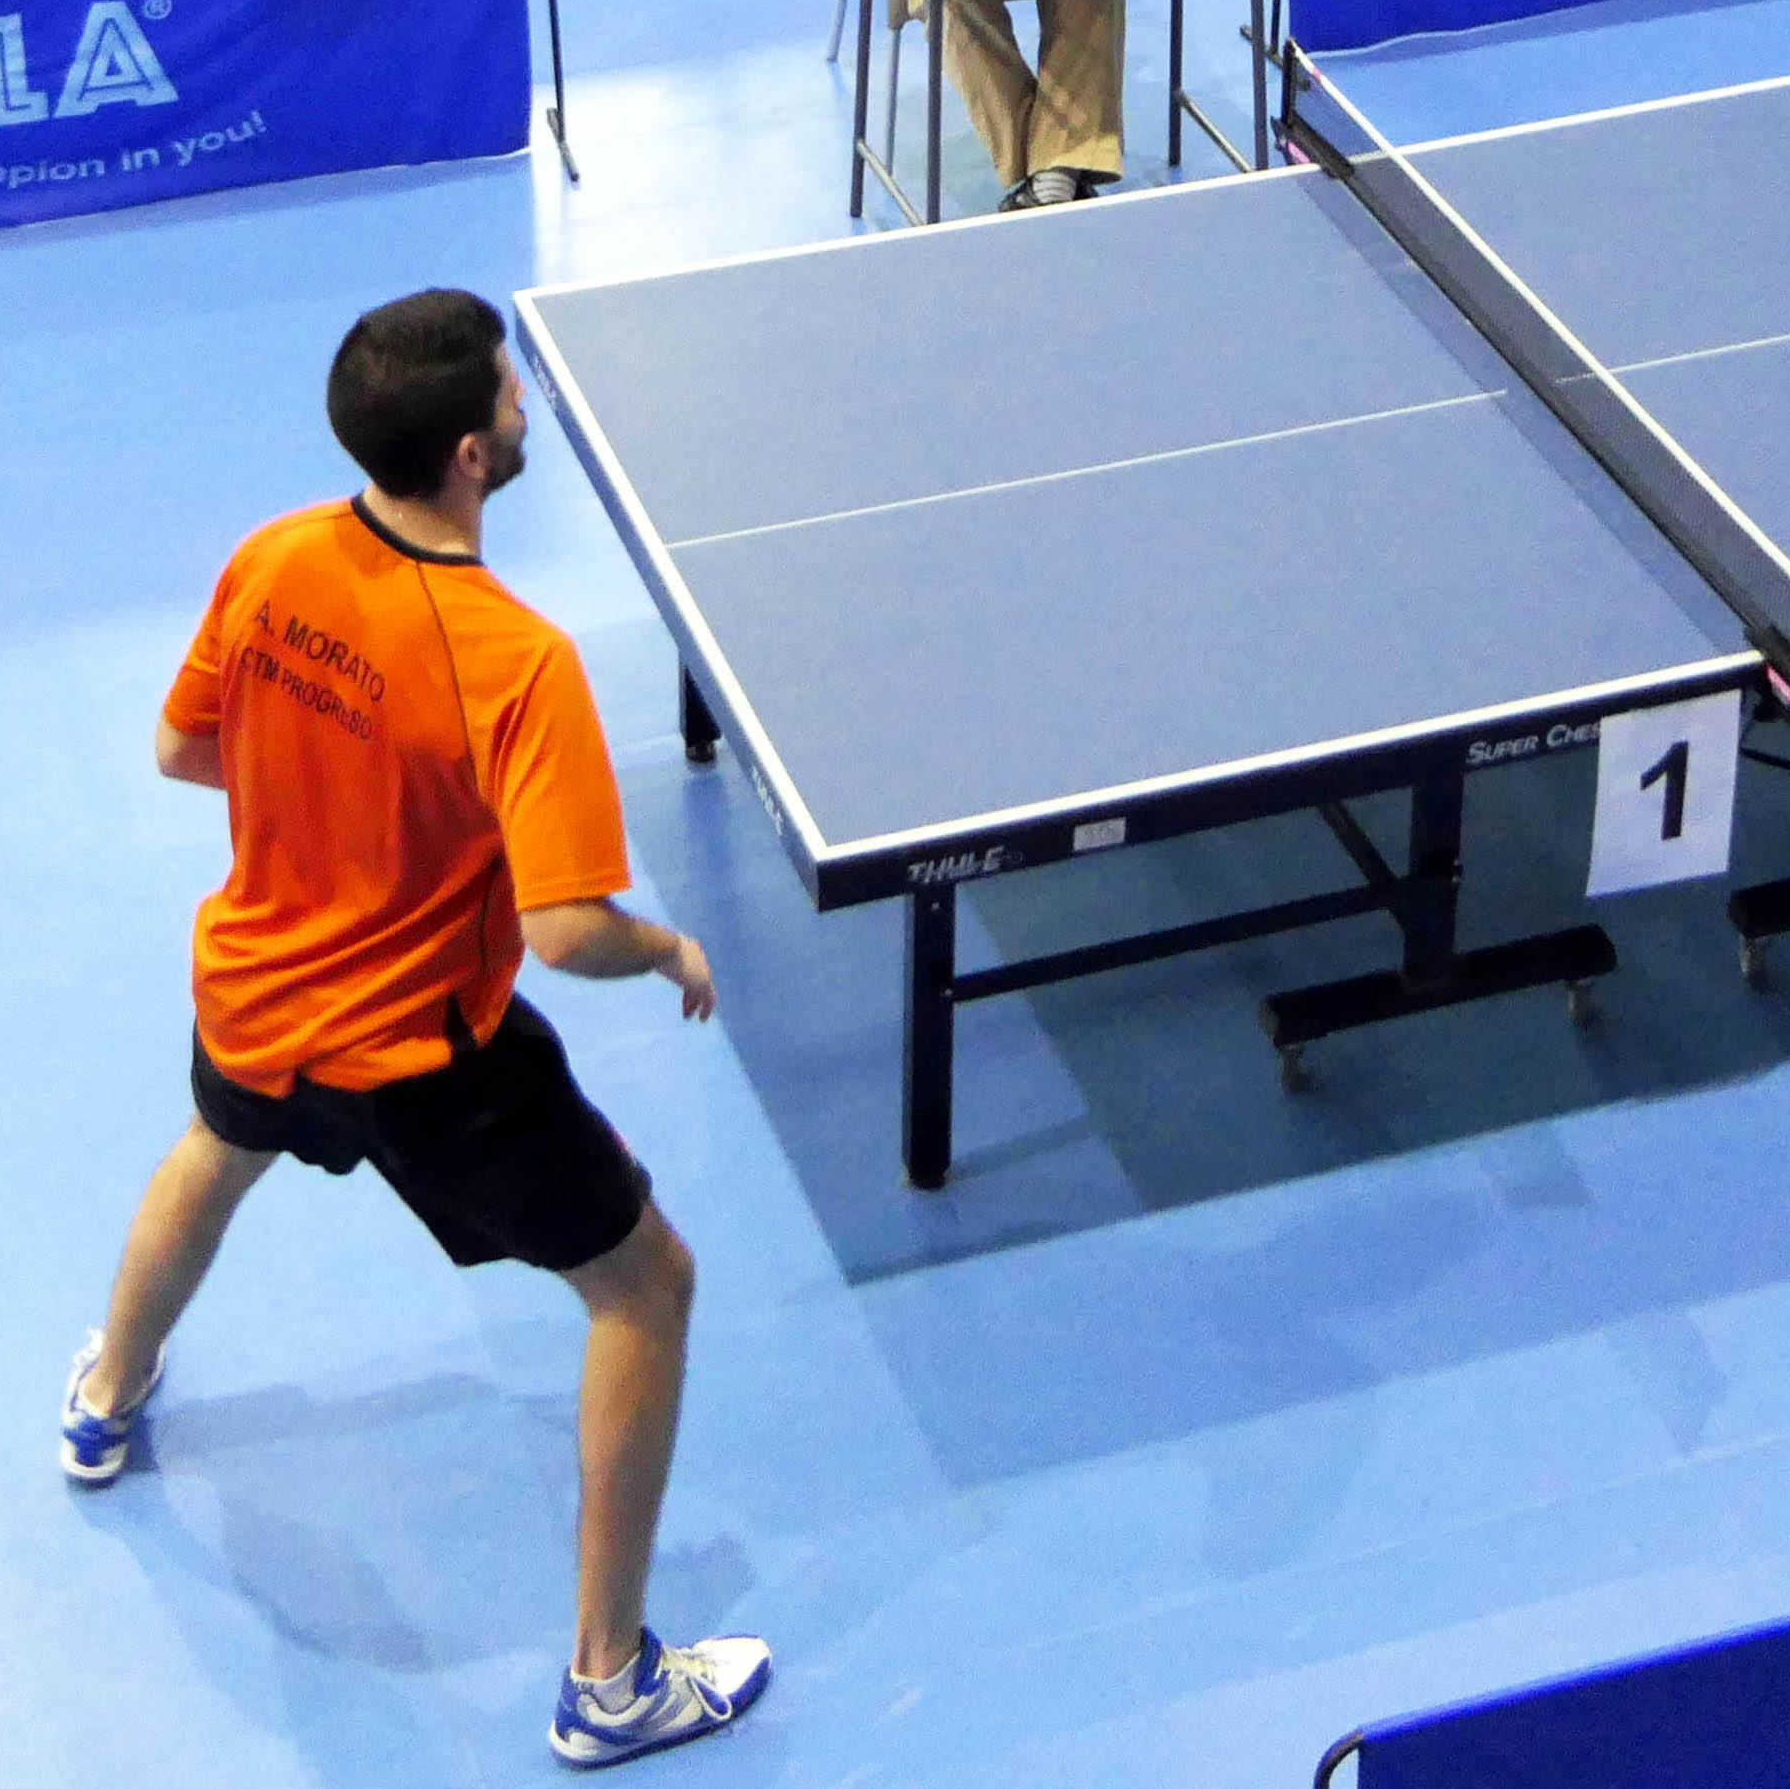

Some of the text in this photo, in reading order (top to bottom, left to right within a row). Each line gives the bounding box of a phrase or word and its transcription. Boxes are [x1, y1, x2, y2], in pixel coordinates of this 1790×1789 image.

[121, 148, 161, 173] in
[171, 111, 268, 170] you!
[255, 598, 387, 703] A. MORATO
[1639, 740, 1690, 841] 1
